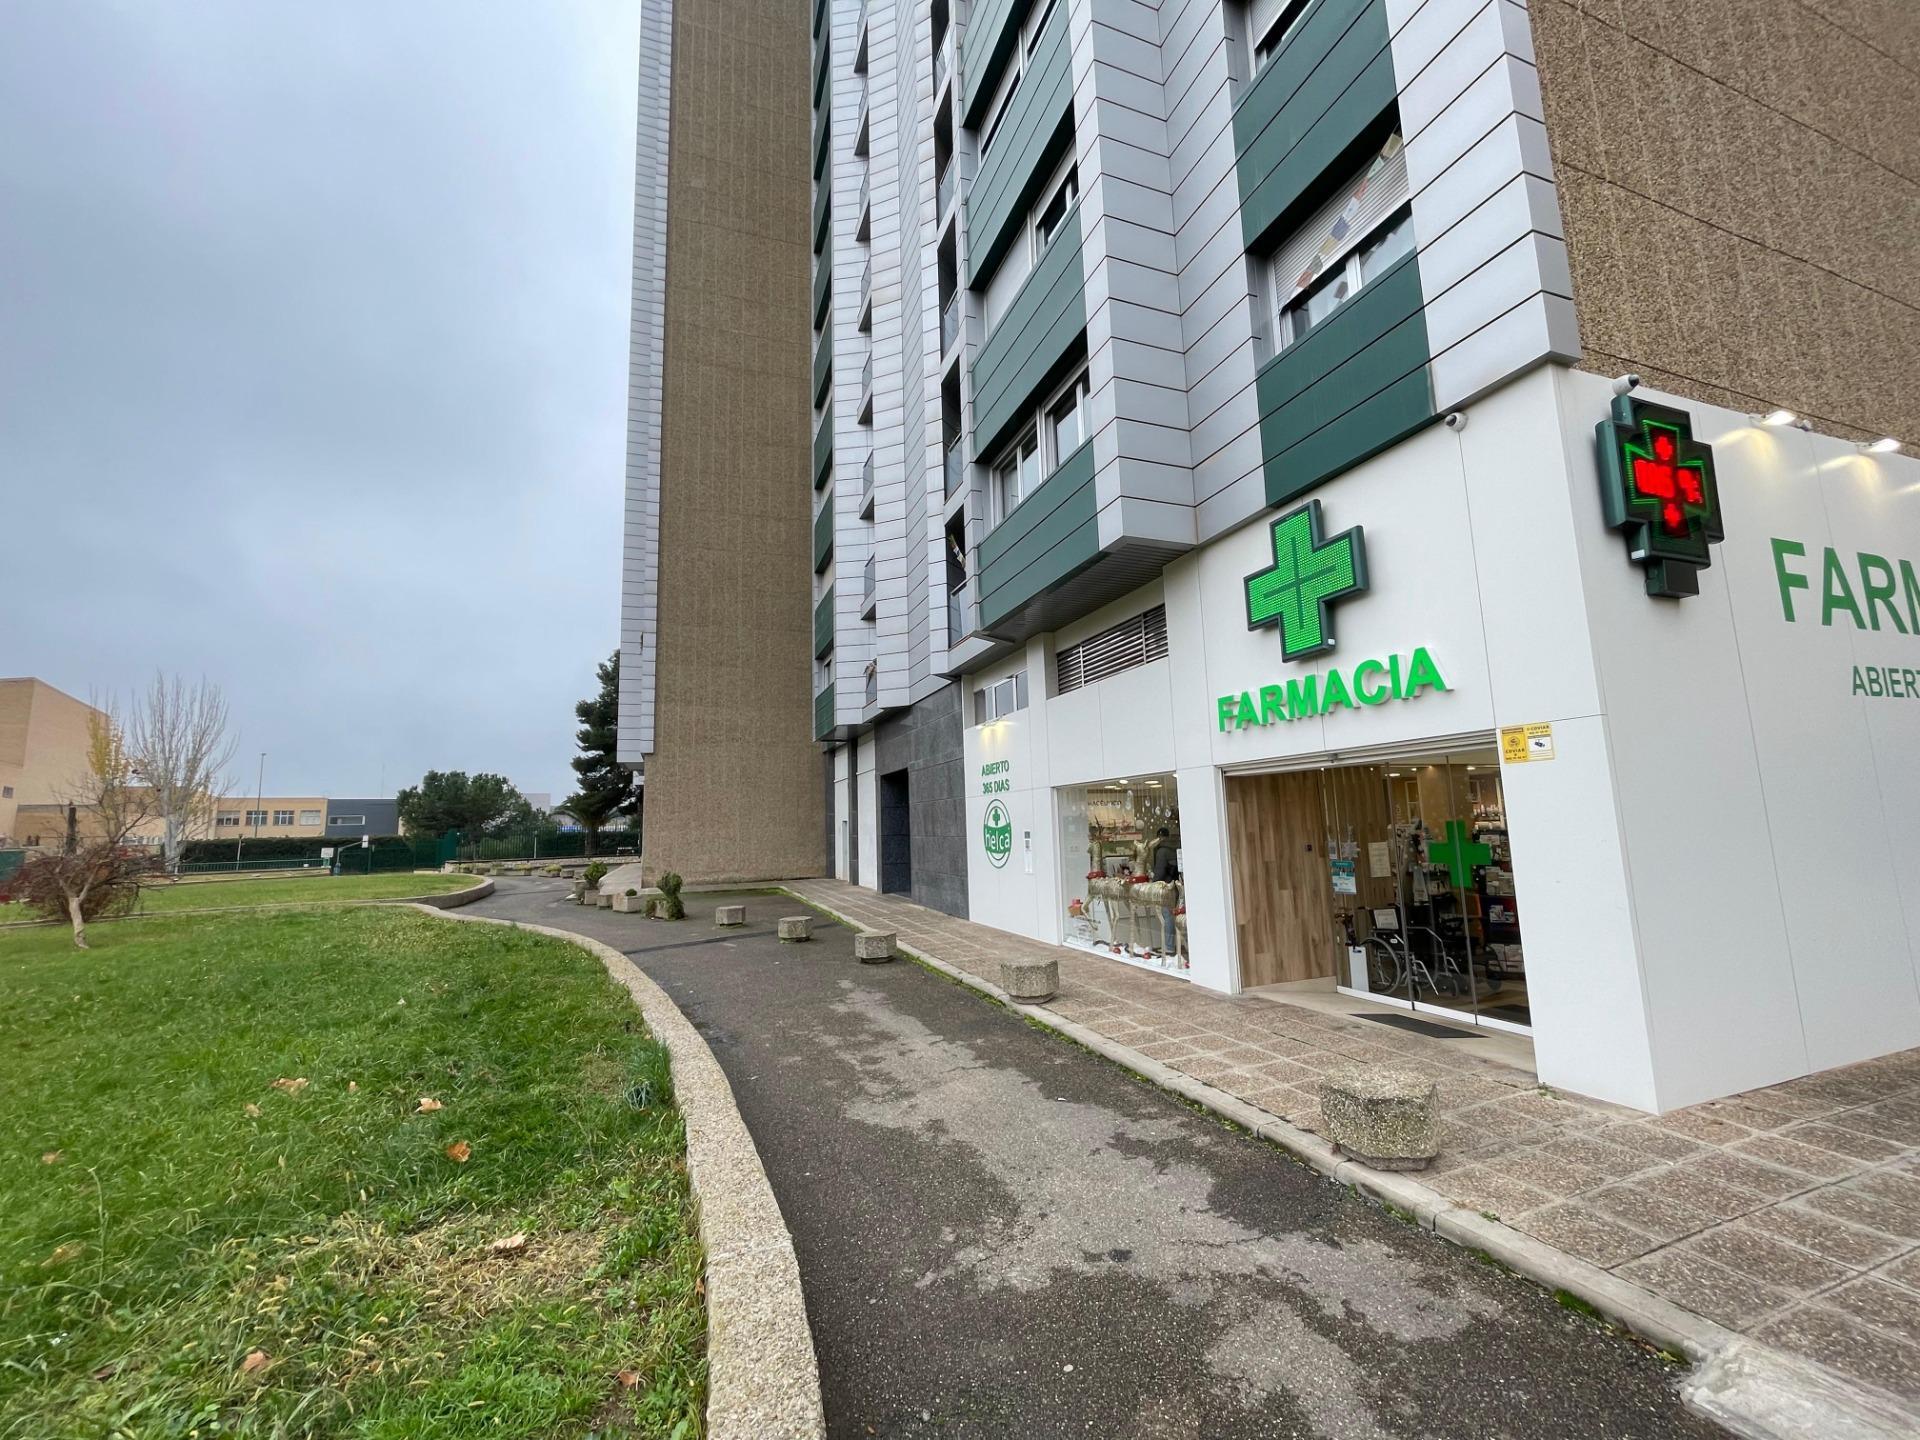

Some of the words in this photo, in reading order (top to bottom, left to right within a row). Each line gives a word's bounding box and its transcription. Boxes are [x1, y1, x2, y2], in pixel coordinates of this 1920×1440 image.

[1217, 647, 1447, 732] FARMACIA
[981, 759, 1010, 777] ABIERTO
[982, 781, 993, 795] 365
[993, 778, 1010, 793] DIAS
[985, 828, 1010, 852] helca
